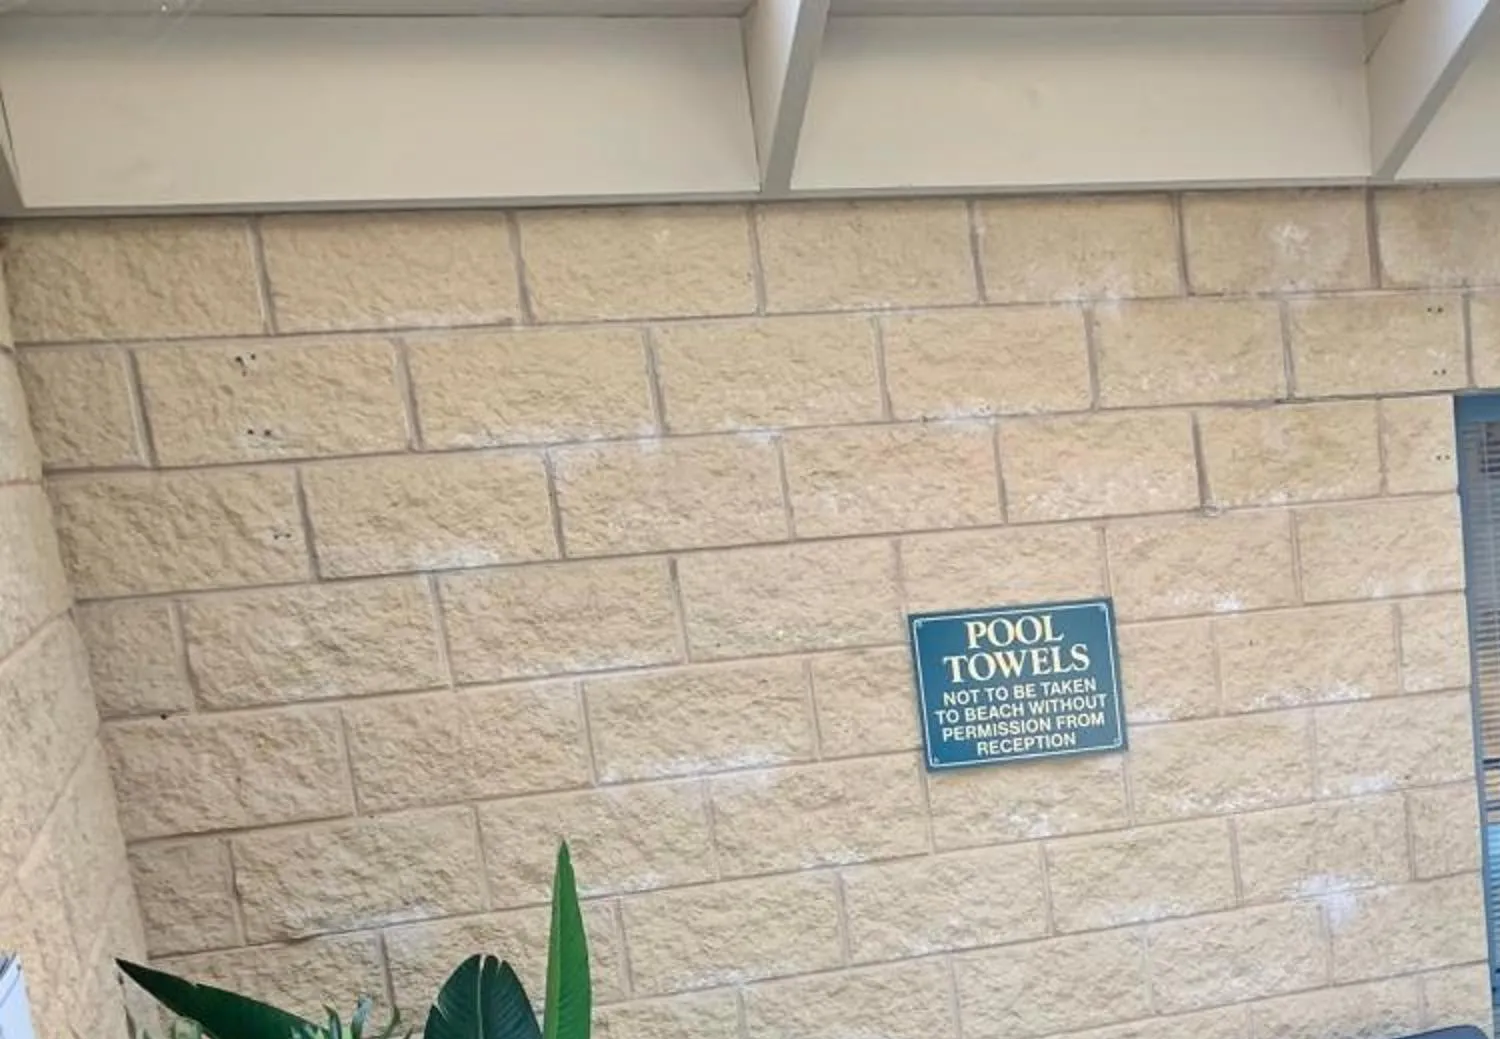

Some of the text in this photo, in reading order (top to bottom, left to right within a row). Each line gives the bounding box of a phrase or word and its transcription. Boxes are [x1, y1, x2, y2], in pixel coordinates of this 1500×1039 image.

[964, 614, 1065, 649] POOL
[943, 643, 1091, 683] TOWELS
[943, 676, 1097, 706] NOT TO BE TAKEN
[934, 693, 1107, 725] TO BEACH WITHOUT
[942, 711, 1105, 742] PERMISSION FROM
[976, 731, 1076, 756] RECEPTION
